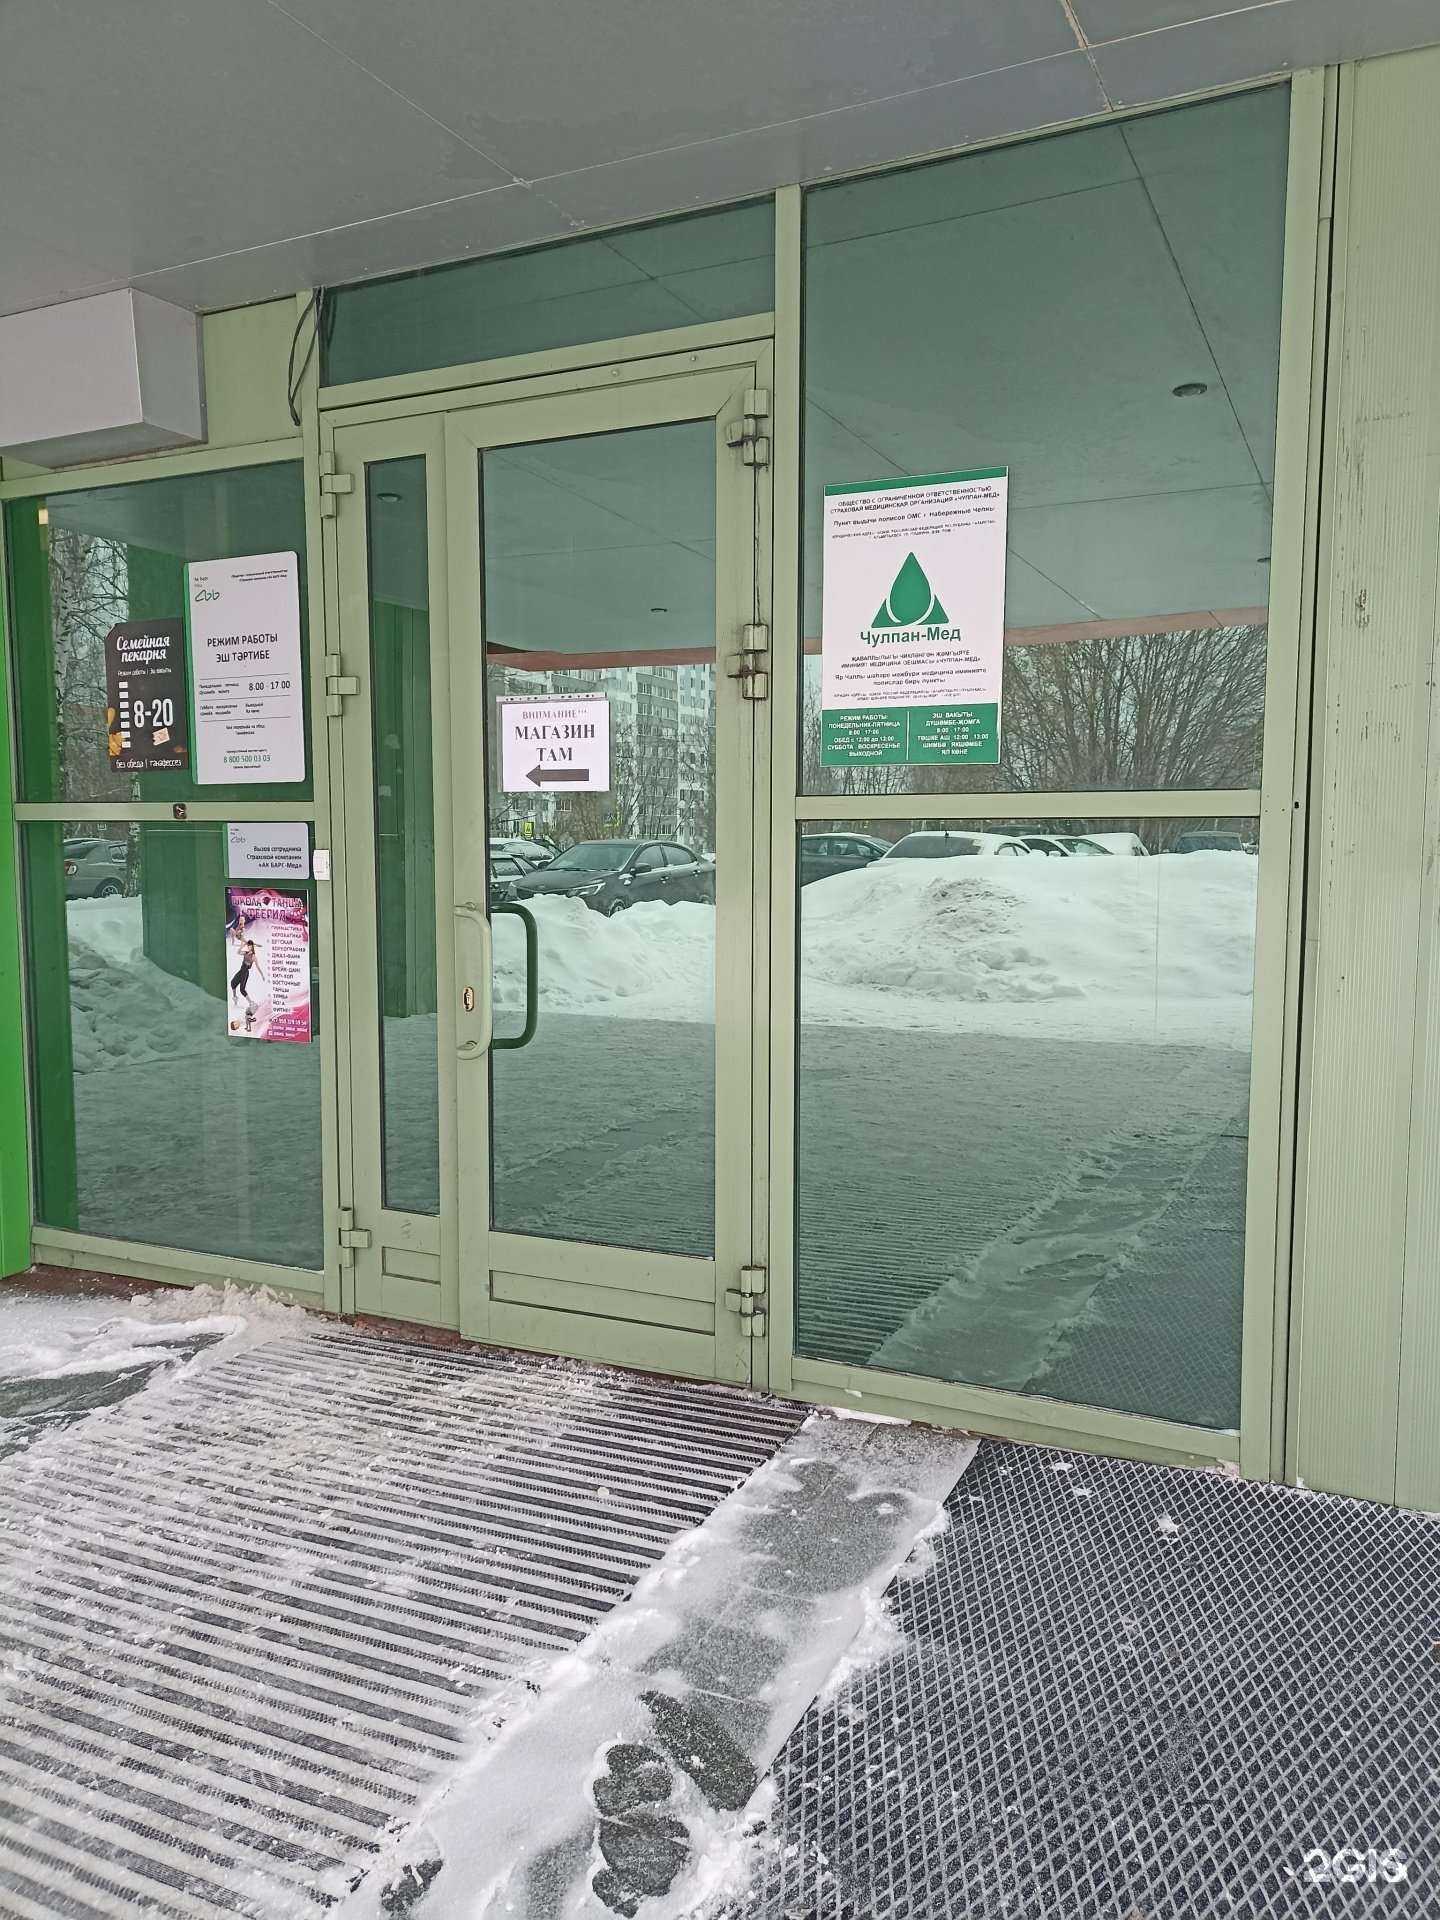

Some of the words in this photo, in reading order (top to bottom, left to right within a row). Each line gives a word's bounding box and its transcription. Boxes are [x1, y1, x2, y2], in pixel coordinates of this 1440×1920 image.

[926, 486, 992, 498] ОТВЕТСТВЕННОСТЬЮ
[830, 506, 864, 514] СТРАХОВАЯ
[864, 502, 909, 511] МЕДИЦИНСКАЯ
[910, 496, 954, 506] ОРГАНИЗАЦИЯ
[834, 520, 851, 528] Пункт
[929, 508, 972, 517] Набережные
[116, 634, 170, 651] Семейная
[207, 637, 240, 648] РЕЖИМ
[241, 633, 279, 644] РАБОТЫ
[860, 626, 962, 648] Чулпан-Мед
[121, 649, 167, 665] пекарня
[216, 654, 230, 663] ЭШ
[232, 650, 270, 661] ТӘРТИБЕ
[133, 698, 174, 728] 8-20
[514, 724, 596, 740] МАГАЗИН
[536, 746, 573, 762] ТАМ
